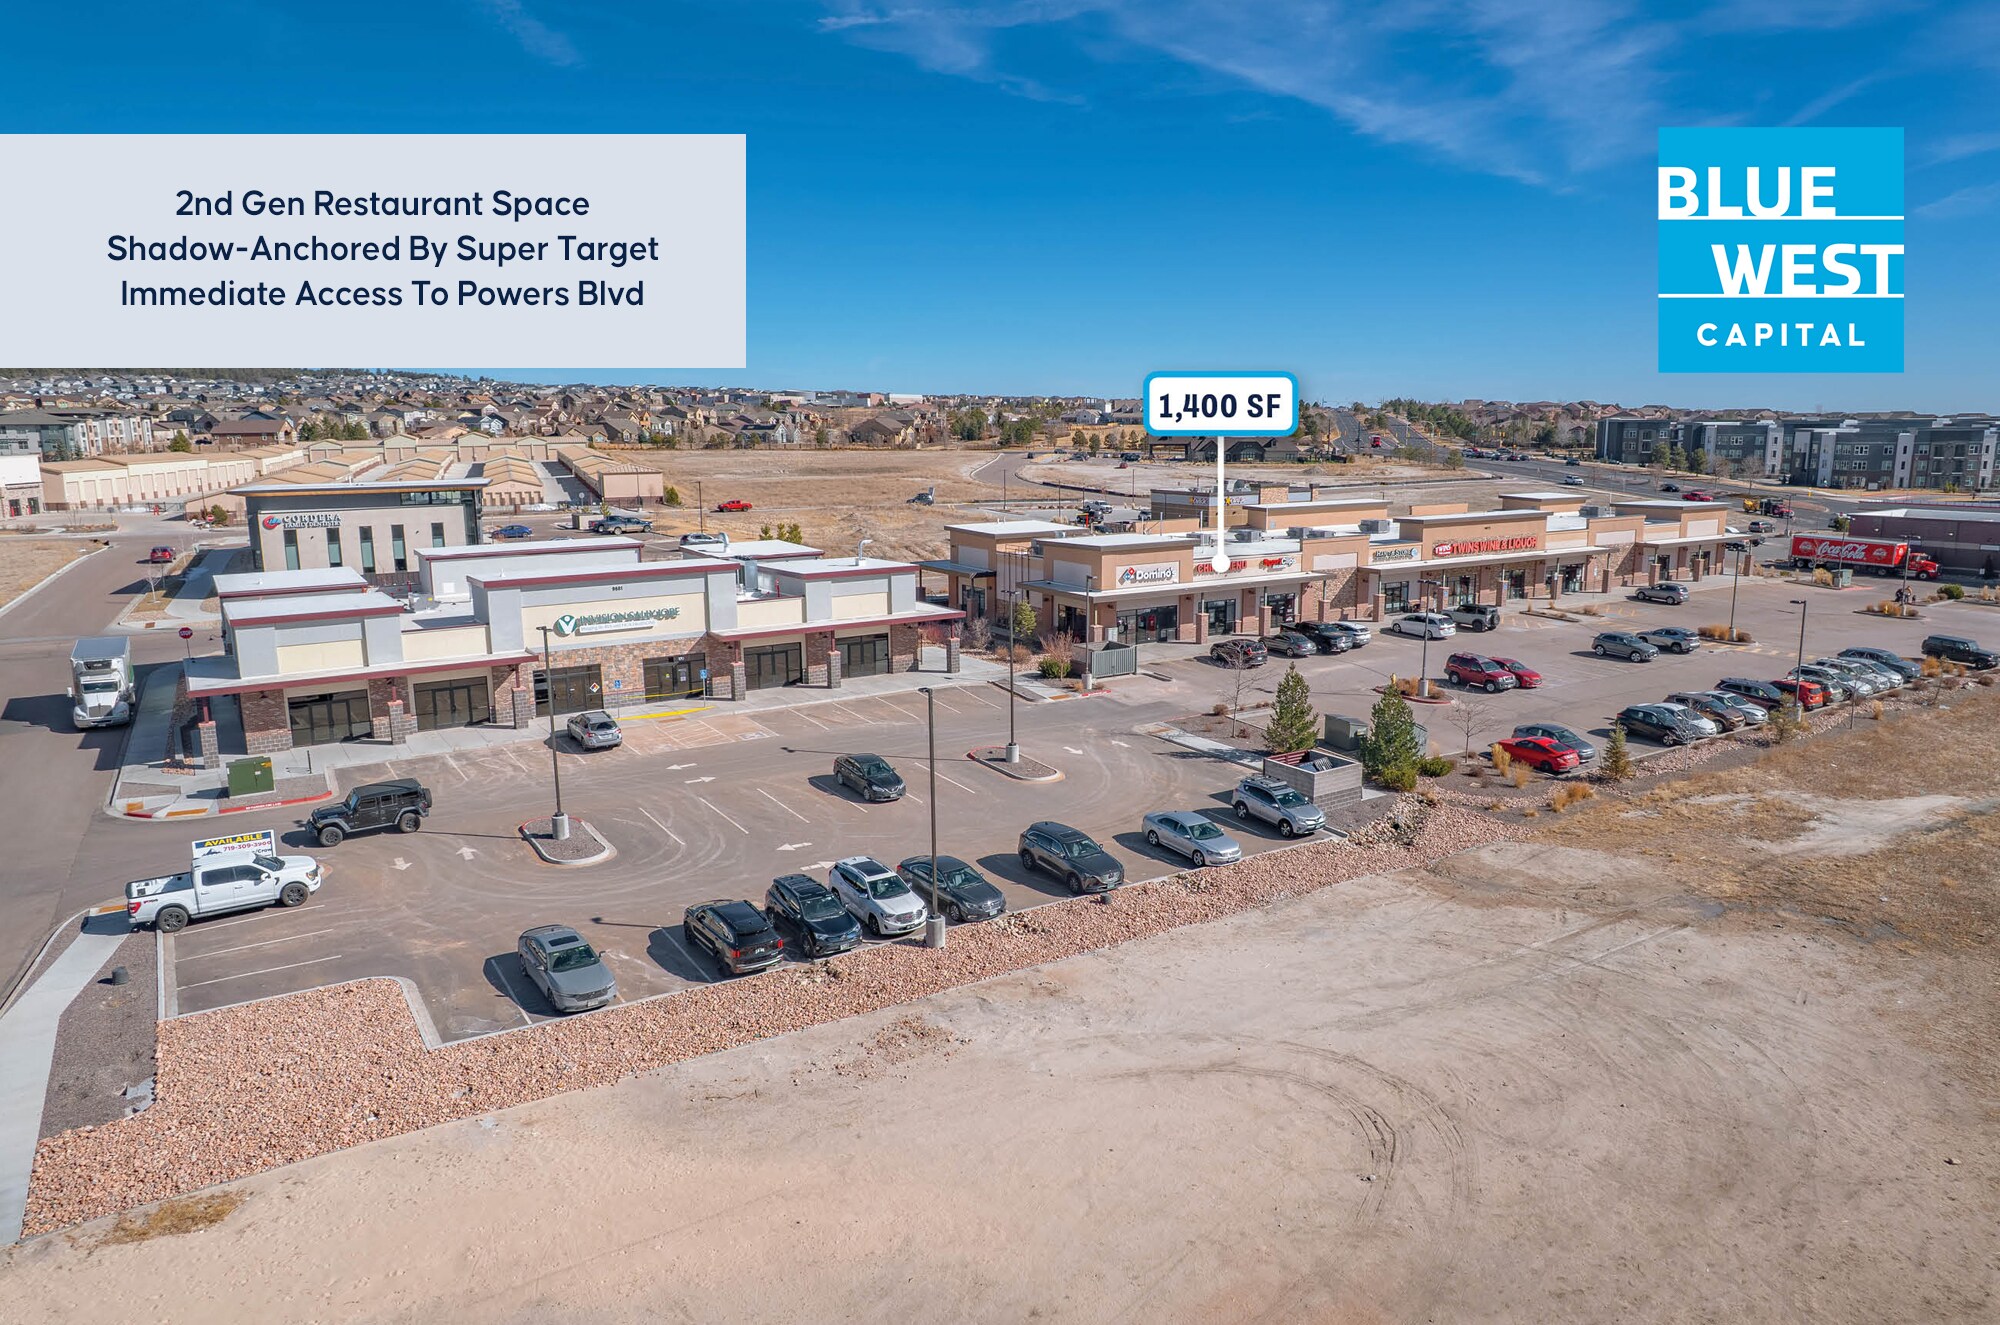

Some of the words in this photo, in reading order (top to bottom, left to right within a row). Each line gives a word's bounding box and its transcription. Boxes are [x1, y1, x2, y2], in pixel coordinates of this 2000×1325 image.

[284, 513, 341, 523] CORDERA
[1453, 542, 1480, 554] TWINS
[1480, 540, 1500, 552] WINE
[1501, 540, 1508, 550] &
[1509, 537, 1537, 549] LIQUOR
[1136, 567, 1177, 580] Domino's
[204, 833, 263, 847] AVAILABLE
